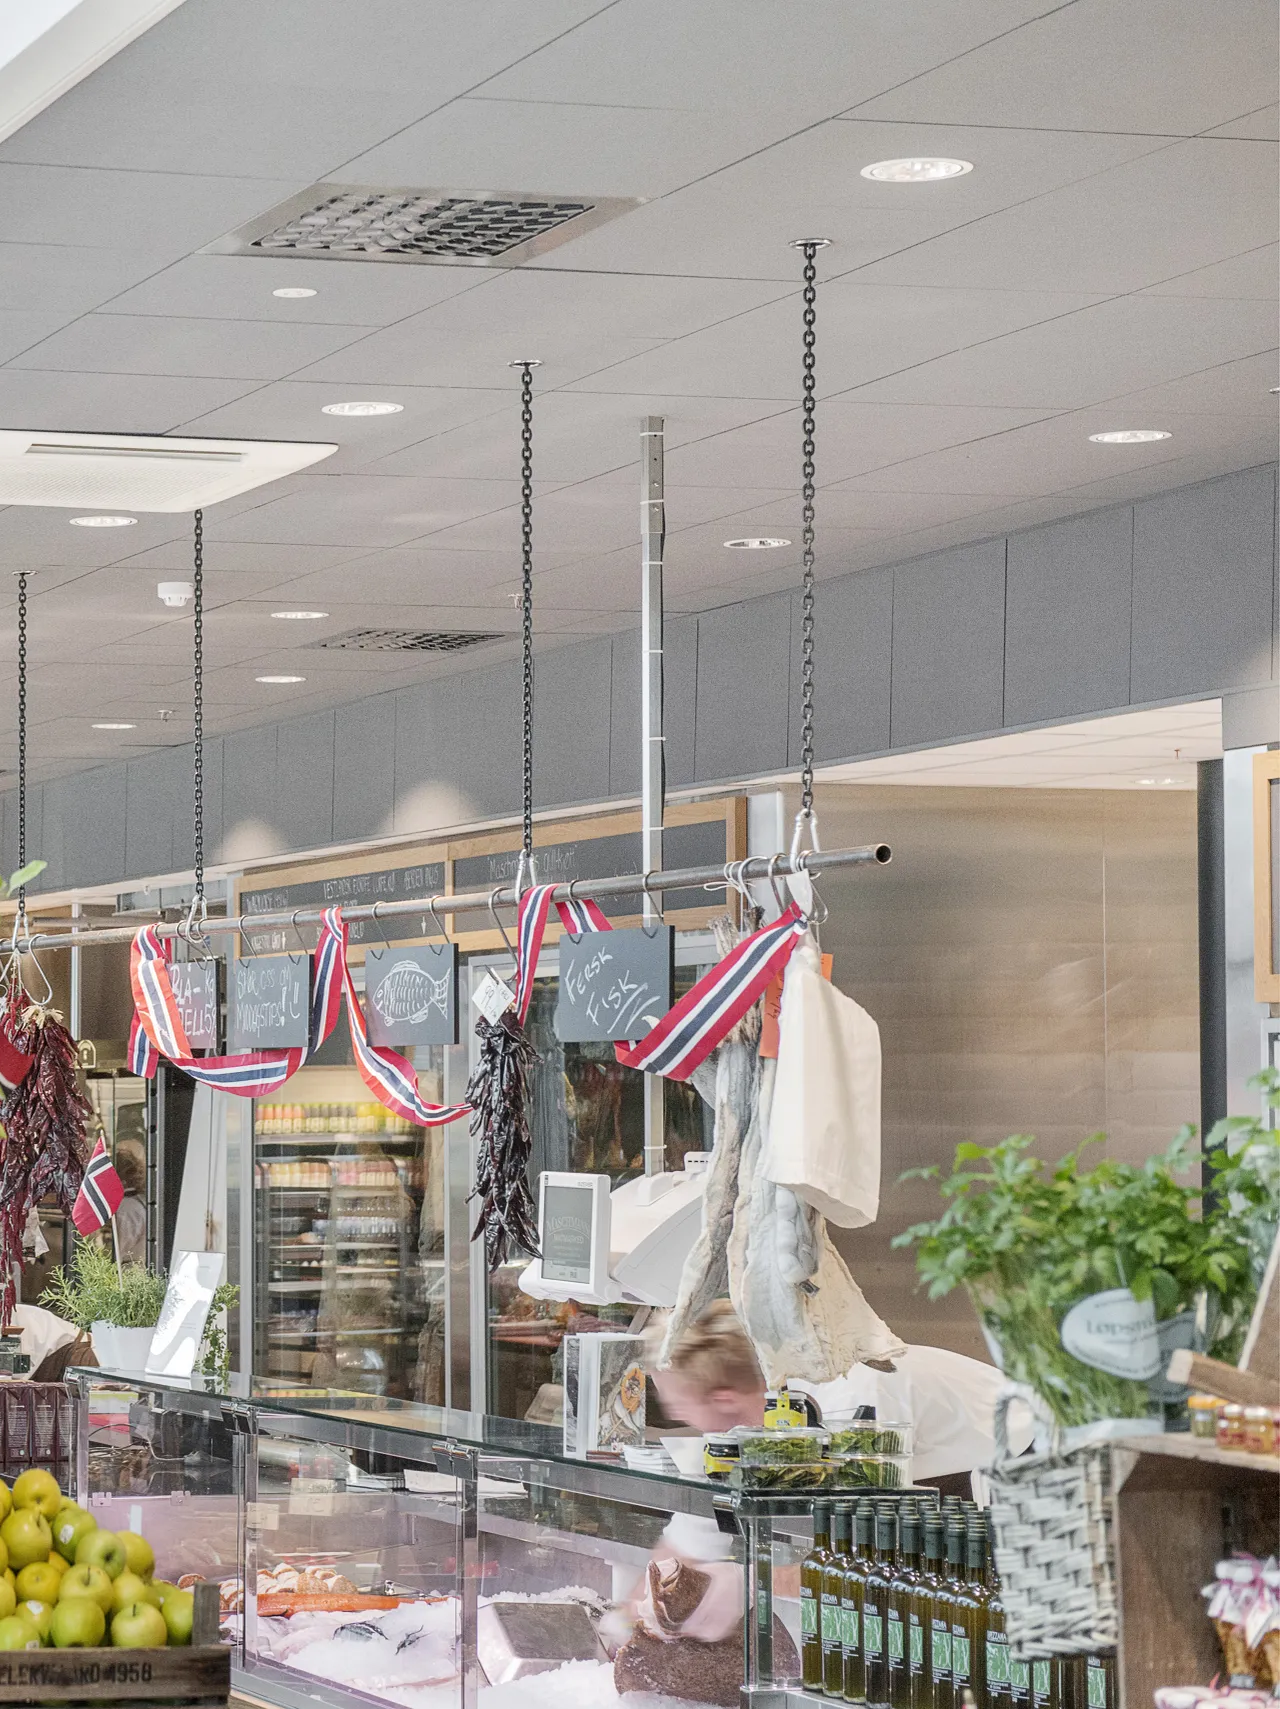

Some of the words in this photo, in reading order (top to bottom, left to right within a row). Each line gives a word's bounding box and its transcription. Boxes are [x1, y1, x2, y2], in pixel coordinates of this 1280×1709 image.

[564, 946, 613, 1005] FERSK
[586, 969, 638, 1026] FISK
[111, 1661, 153, 1684] 1958
